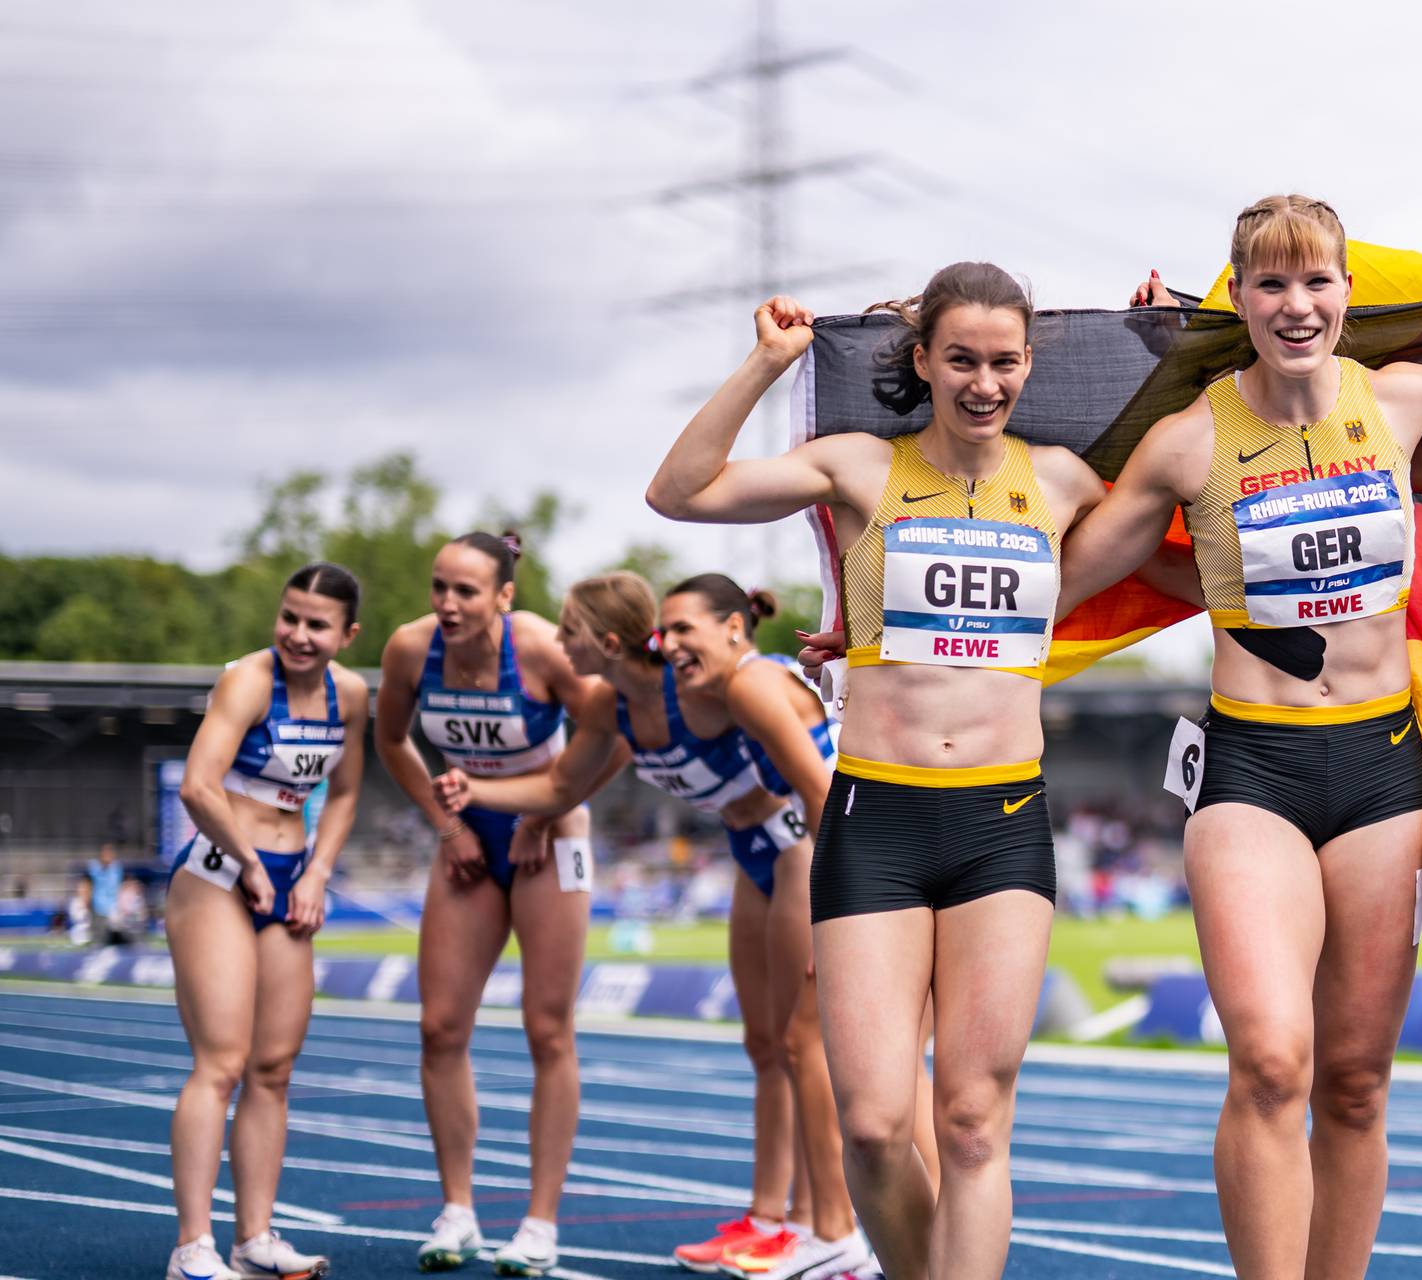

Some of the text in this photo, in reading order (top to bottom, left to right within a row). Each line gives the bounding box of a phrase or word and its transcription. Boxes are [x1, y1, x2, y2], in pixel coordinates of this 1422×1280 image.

[1240, 454, 1377, 495] GERMANY
[1249, 482, 1387, 521] RHINE-RUHR 2025
[898, 527, 1038, 553] RHINE-RUHR 2025
[1291, 525, 1363, 572] GER
[924, 562, 1020, 611] GER
[1327, 578, 1350, 589] FISU
[1298, 593, 1363, 619] REWE
[966, 621, 990, 629] FISU
[933, 637, 999, 658] REWE
[445, 719, 506, 747] SVK
[291, 753, 328, 777] SVK
[1181, 743, 1200, 791] 6
[782, 811, 808, 838] 8
[572, 851, 585, 880] 8
